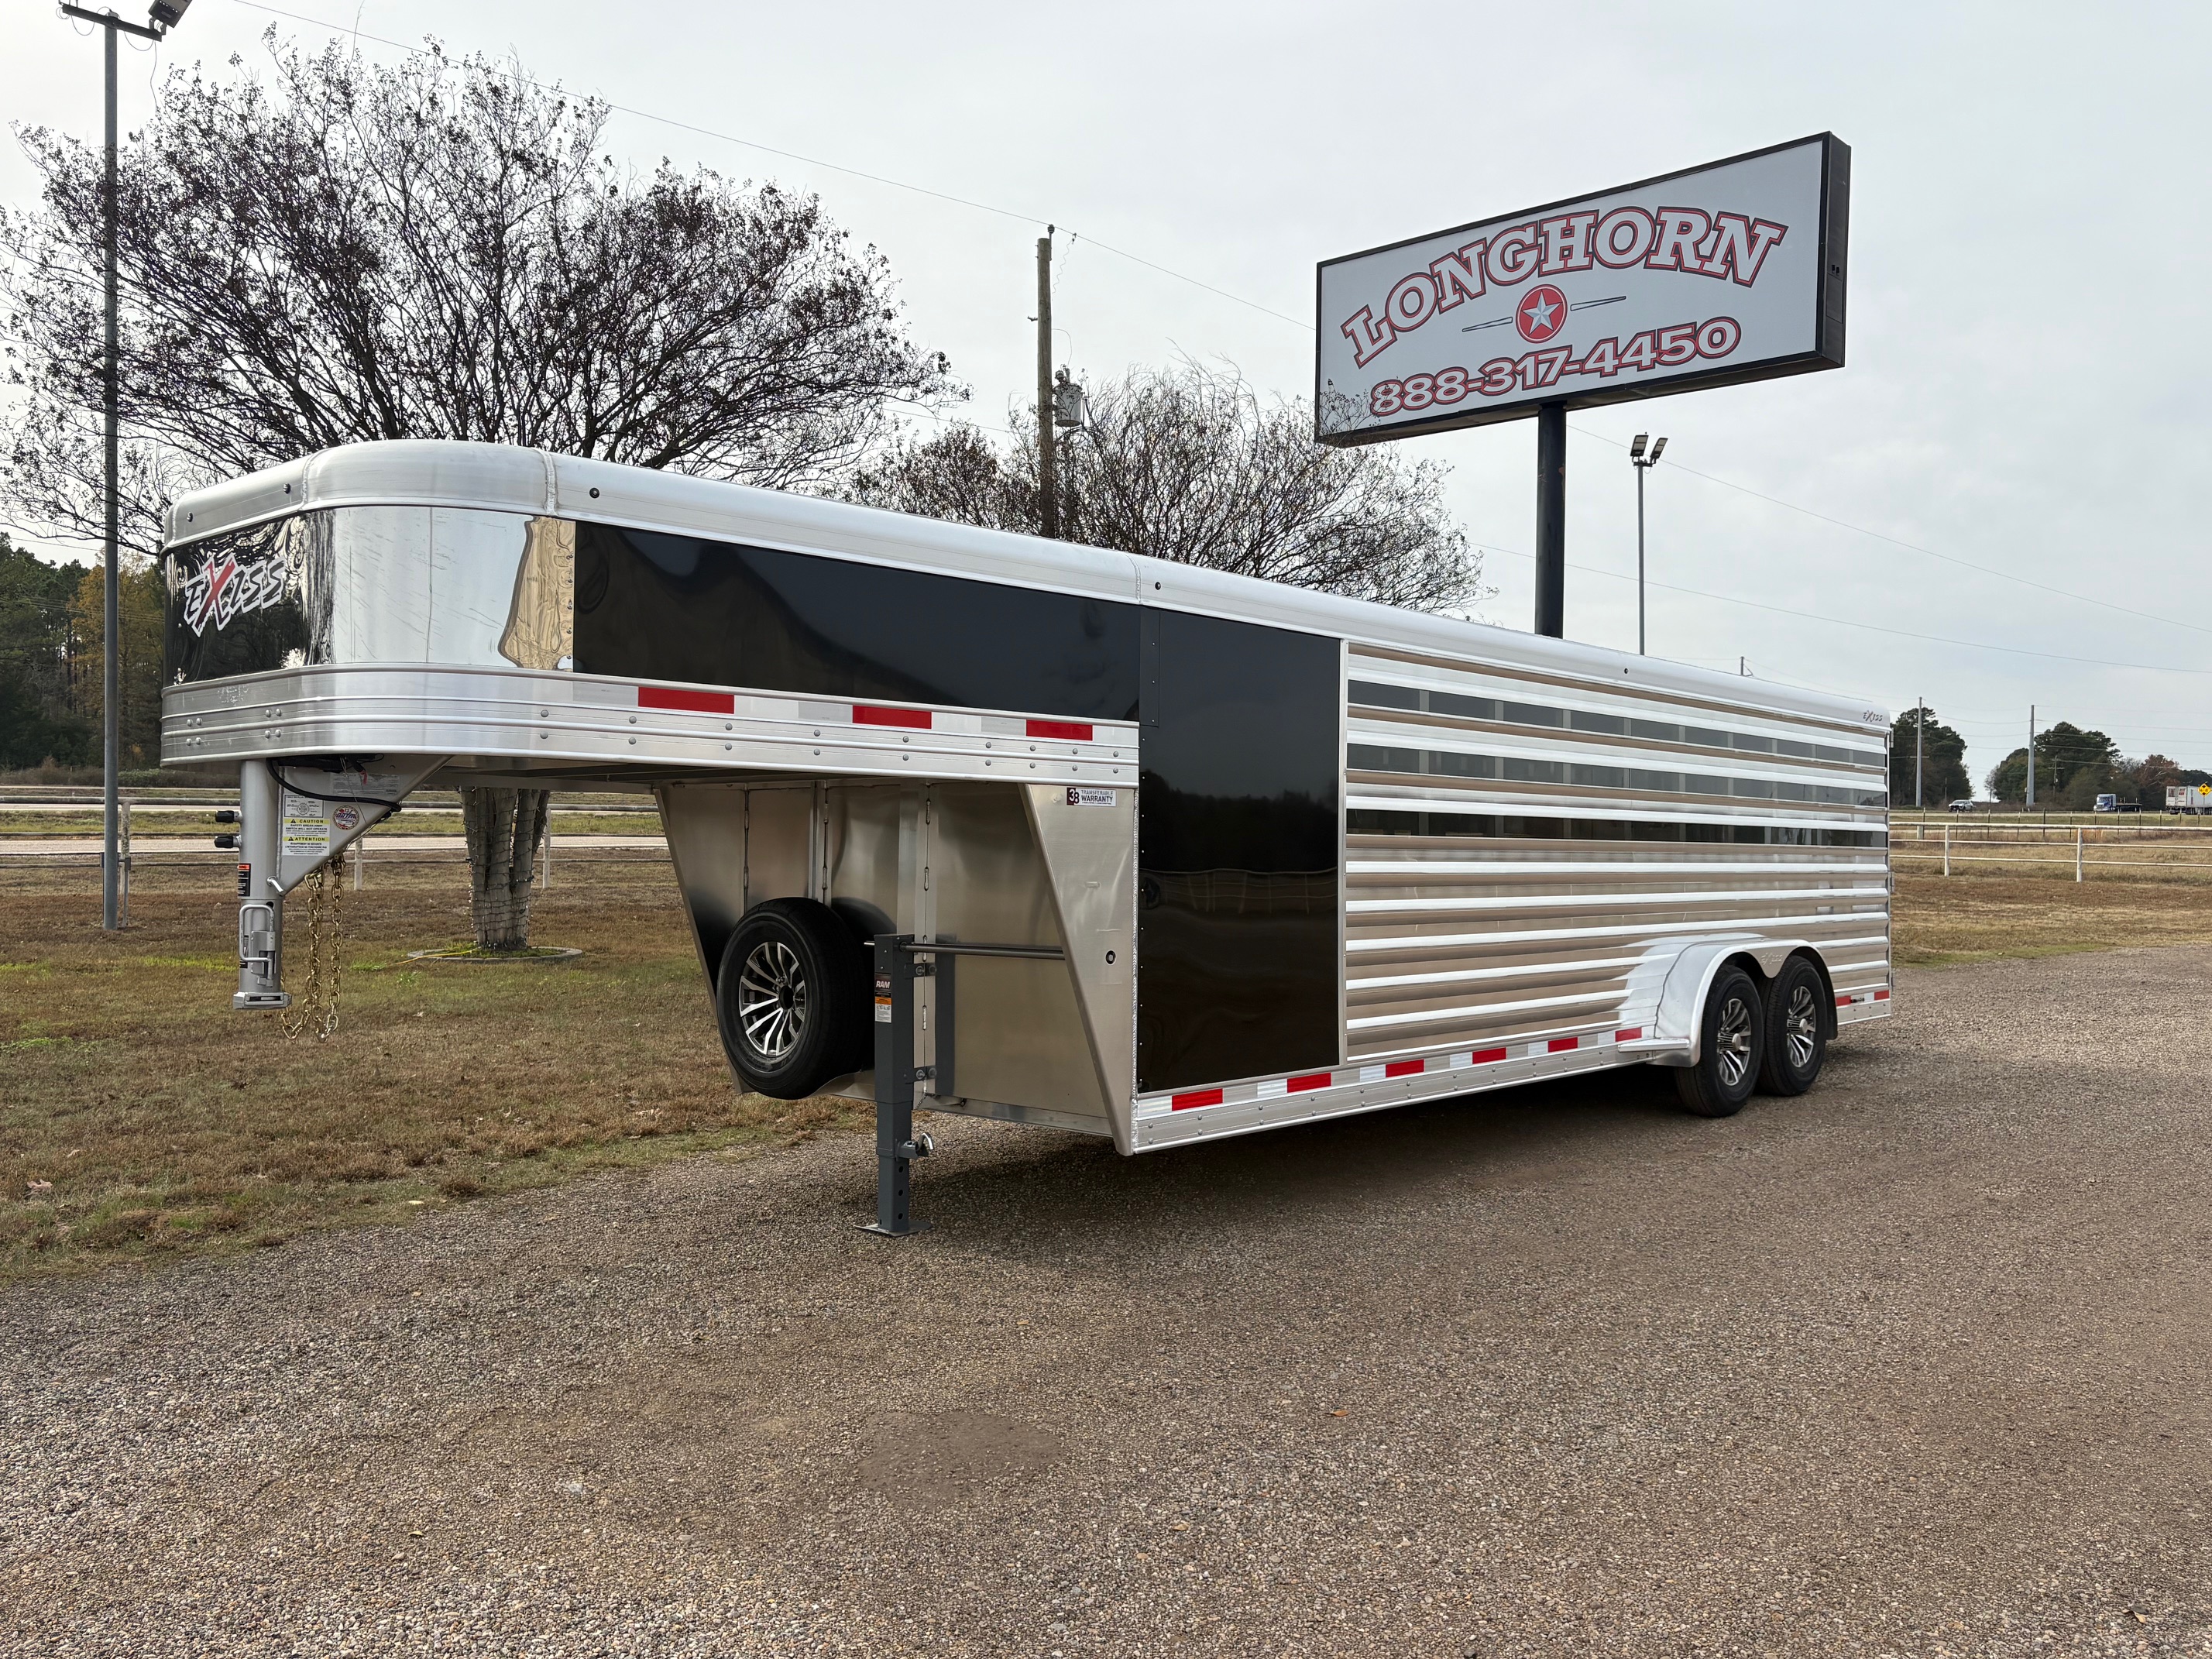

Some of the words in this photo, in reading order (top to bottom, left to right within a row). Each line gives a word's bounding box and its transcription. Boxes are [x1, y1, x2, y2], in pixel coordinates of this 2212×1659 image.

[1341, 206, 1788, 369] LONGHORN
[1369, 316, 1741, 417] 888-317-4450
[876, 980, 891, 989] RAM
